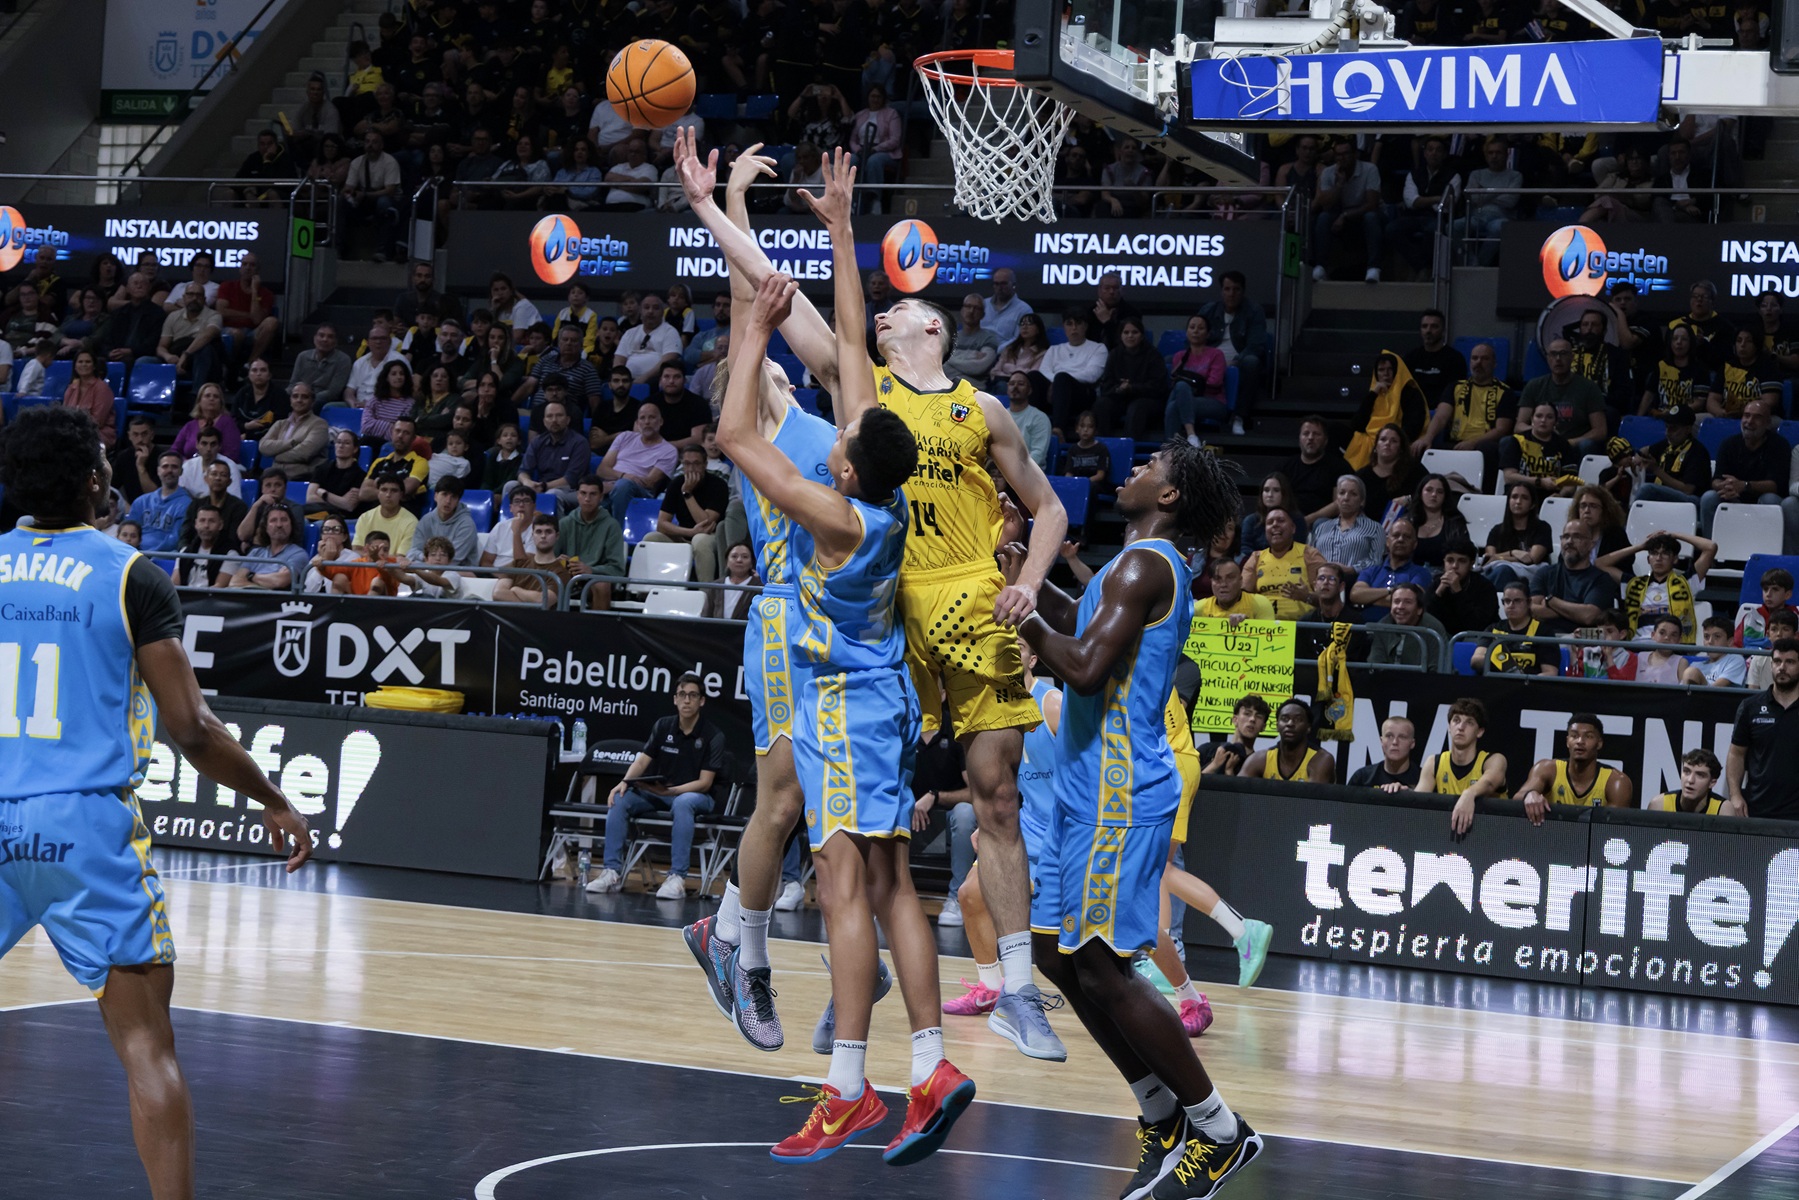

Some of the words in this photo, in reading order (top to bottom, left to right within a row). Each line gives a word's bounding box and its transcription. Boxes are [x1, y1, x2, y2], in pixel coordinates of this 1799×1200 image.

[1276, 52, 1577, 115] HOVIMA
[115, 99, 157, 110] SALIDA
[11, 225, 69, 247] gasten
[104, 219, 260, 241] INSTALACIONES
[669, 227, 834, 250] INSTCIONE
[566, 233, 629, 260] gasten
[922, 240, 990, 269] gasten
[1034, 233, 1225, 257] INSTALACIONES
[579, 256, 616, 276] solar
[676, 257, 833, 280] INDUALES
[1589, 247, 1668, 278] gasten
[936, 267, 976, 285] solar
[1605, 272, 1653, 296] slar
[910, 500, 944, 537] 14
[1, 602, 81, 623] CaixaBank
[326, 622, 471, 686] DXT
[520, 647, 671, 694] Pabellón
[0, 642, 61, 739] 11
[520, 690, 585, 715] Santiago
[589, 698, 638, 717] Martín
[1301, 915, 1494, 964] despierta
[1514, 945, 1741, 988] emociones
